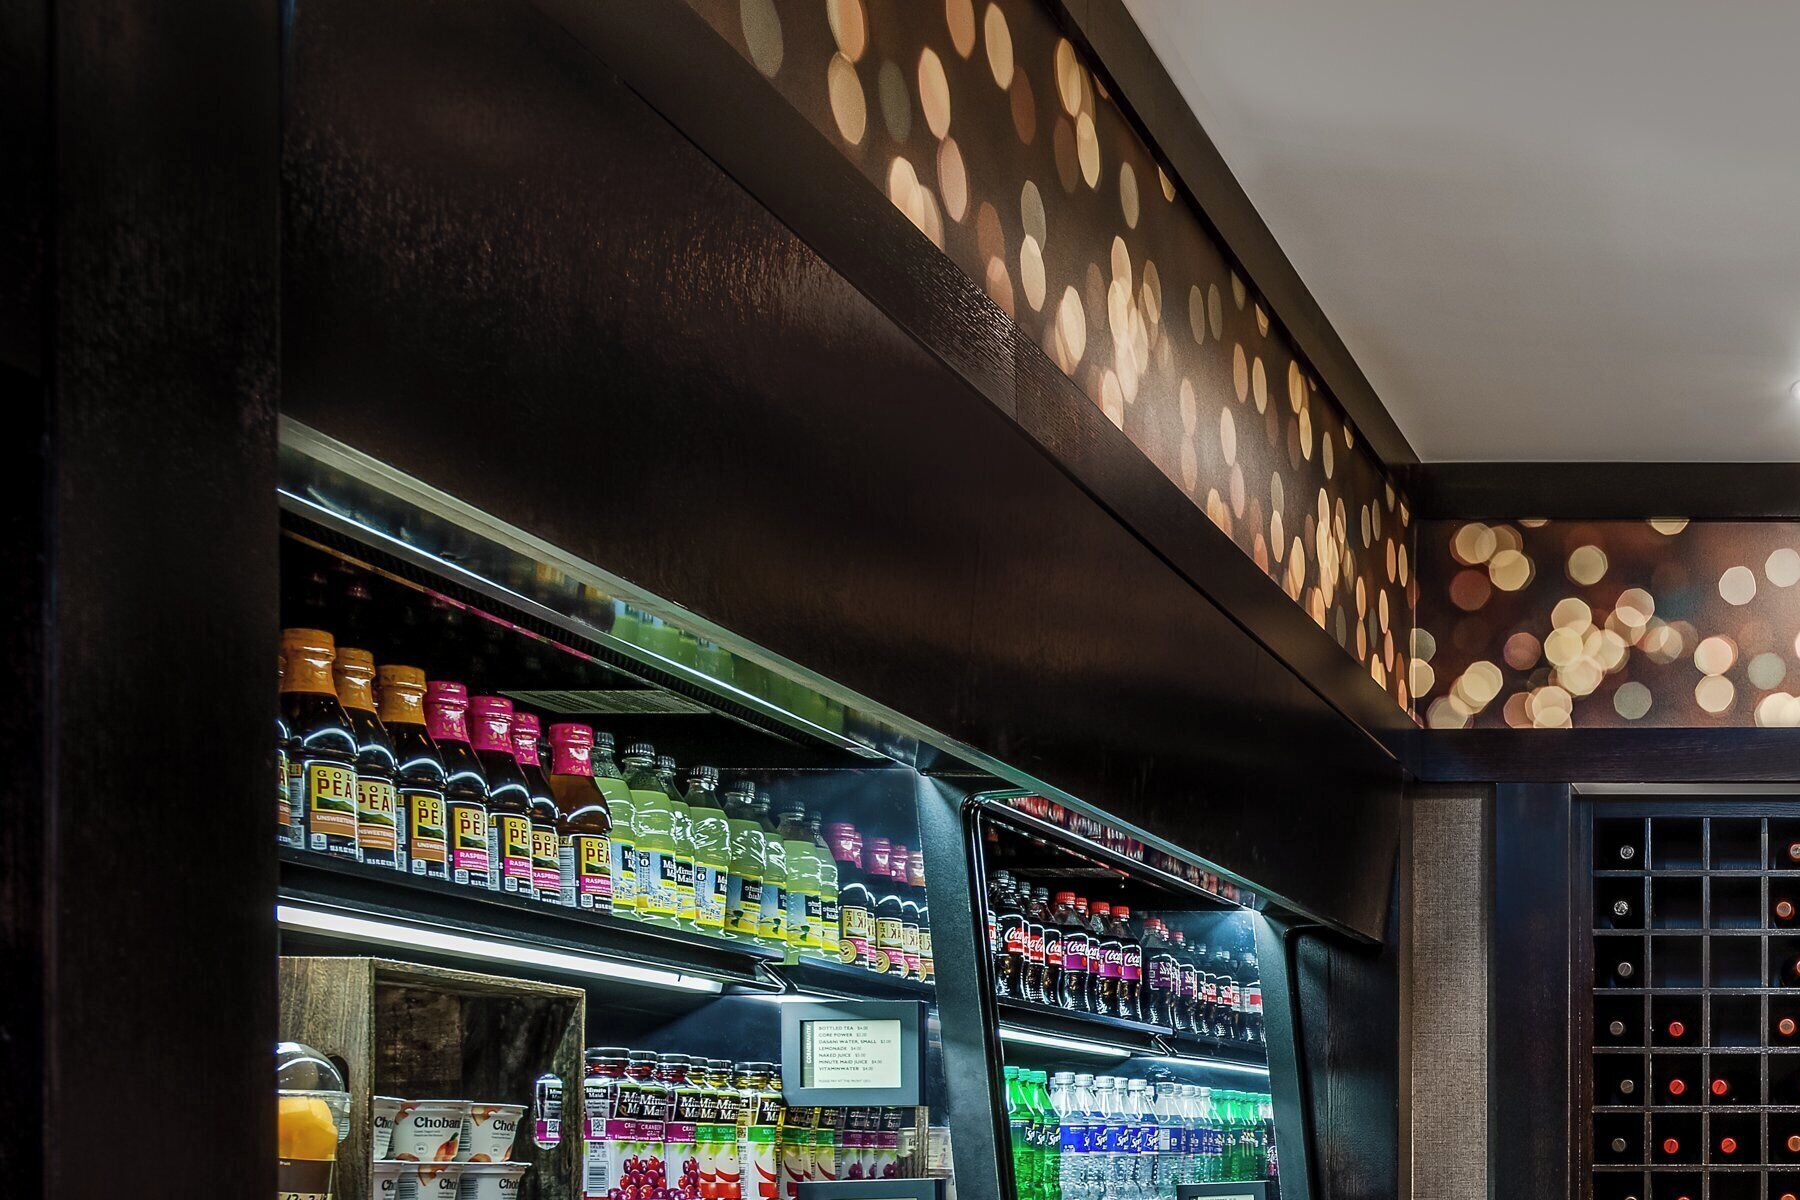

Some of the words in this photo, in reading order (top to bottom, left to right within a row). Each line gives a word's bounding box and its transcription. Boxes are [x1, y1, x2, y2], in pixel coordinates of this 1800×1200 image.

[316, 777, 354, 797] PEA
[533, 841, 558, 858] PEA
[586, 847, 611, 864] PEA
[640, 1093, 667, 1106] Minu
